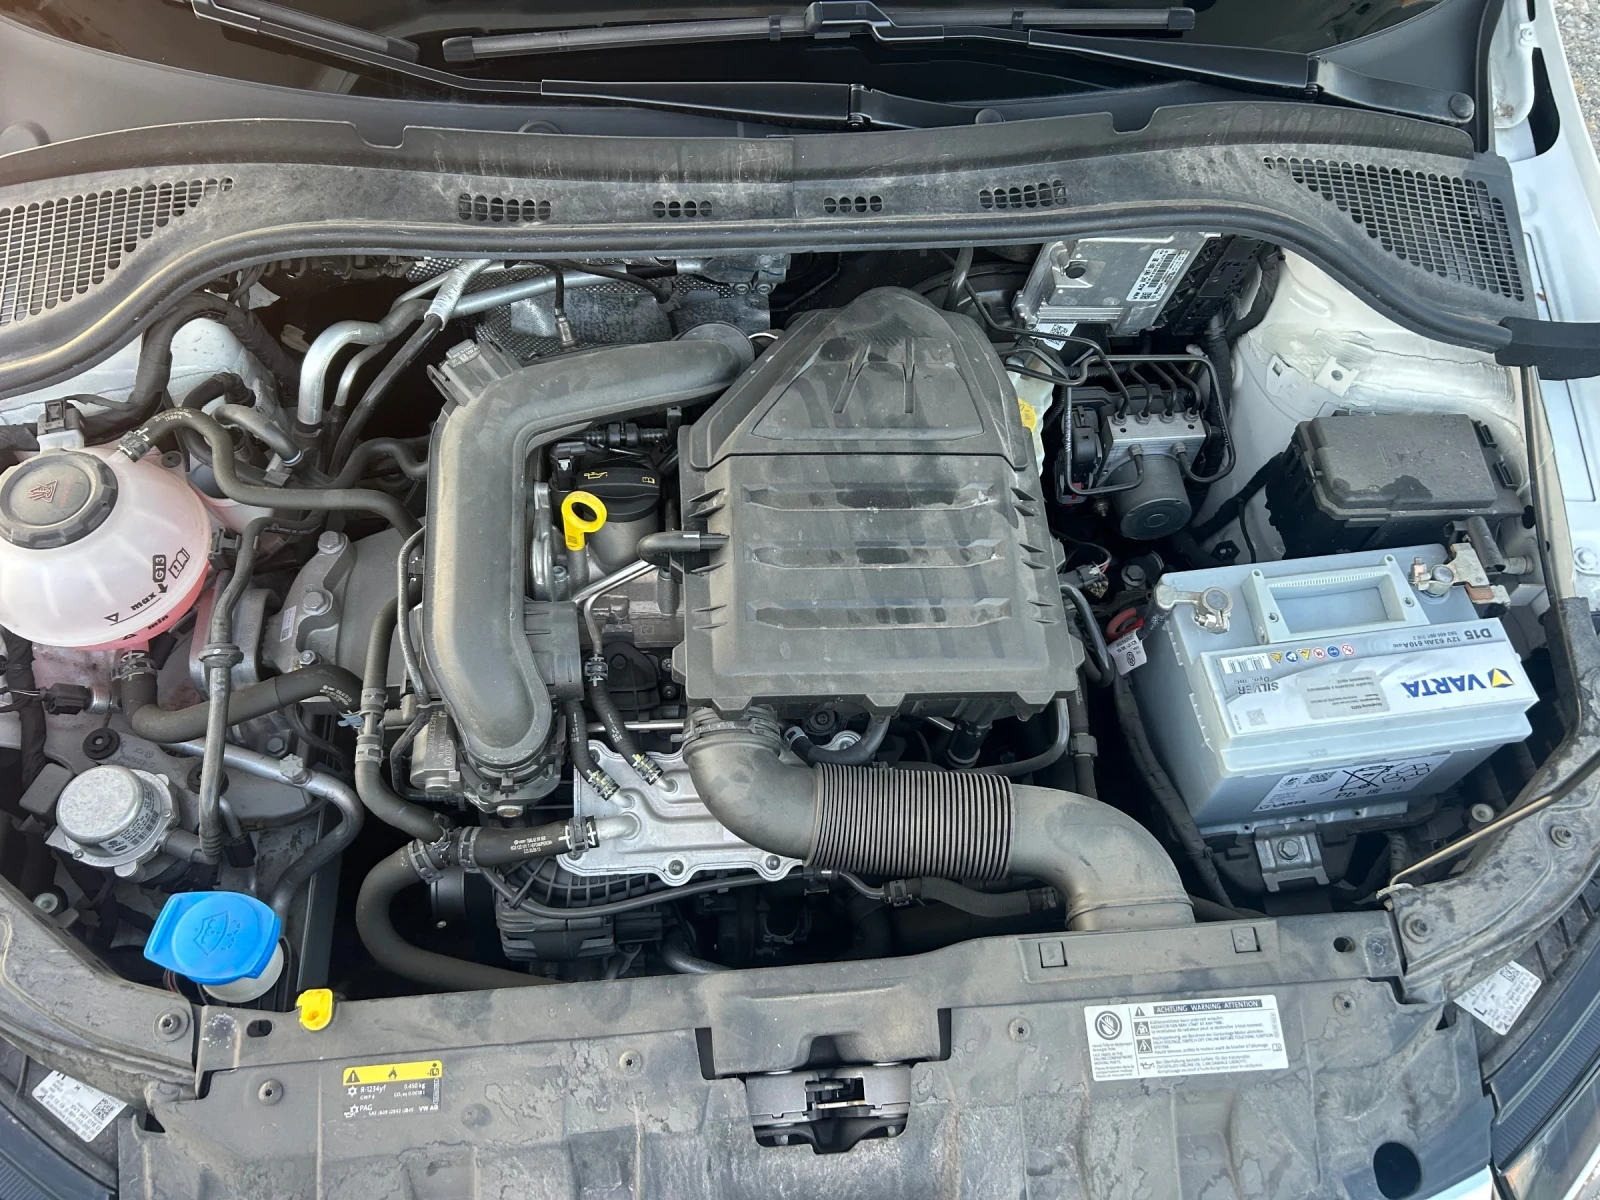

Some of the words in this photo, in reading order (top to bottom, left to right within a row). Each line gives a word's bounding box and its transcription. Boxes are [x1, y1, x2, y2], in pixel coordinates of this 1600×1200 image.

[155, 556, 165, 580] G13
[131, 592, 156, 611] max
[148, 614, 168, 630] min
[1464, 627, 1492, 641] D15
[1424, 637, 1444, 646] 63Ah
[1237, 681, 1279, 695] SILVER
[1401, 672, 1486, 698] VARTA
[1272, 800, 1306, 808] VARTA
[1156, 1005, 1188, 1014] ACHTUNG
[1190, 1003, 1221, 1011] WARNING
[1224, 1000, 1258, 1009] ATTENTION
[1474, 1008, 1487, 1016] L
[360, 1084, 387, 1094] R-1234yf
